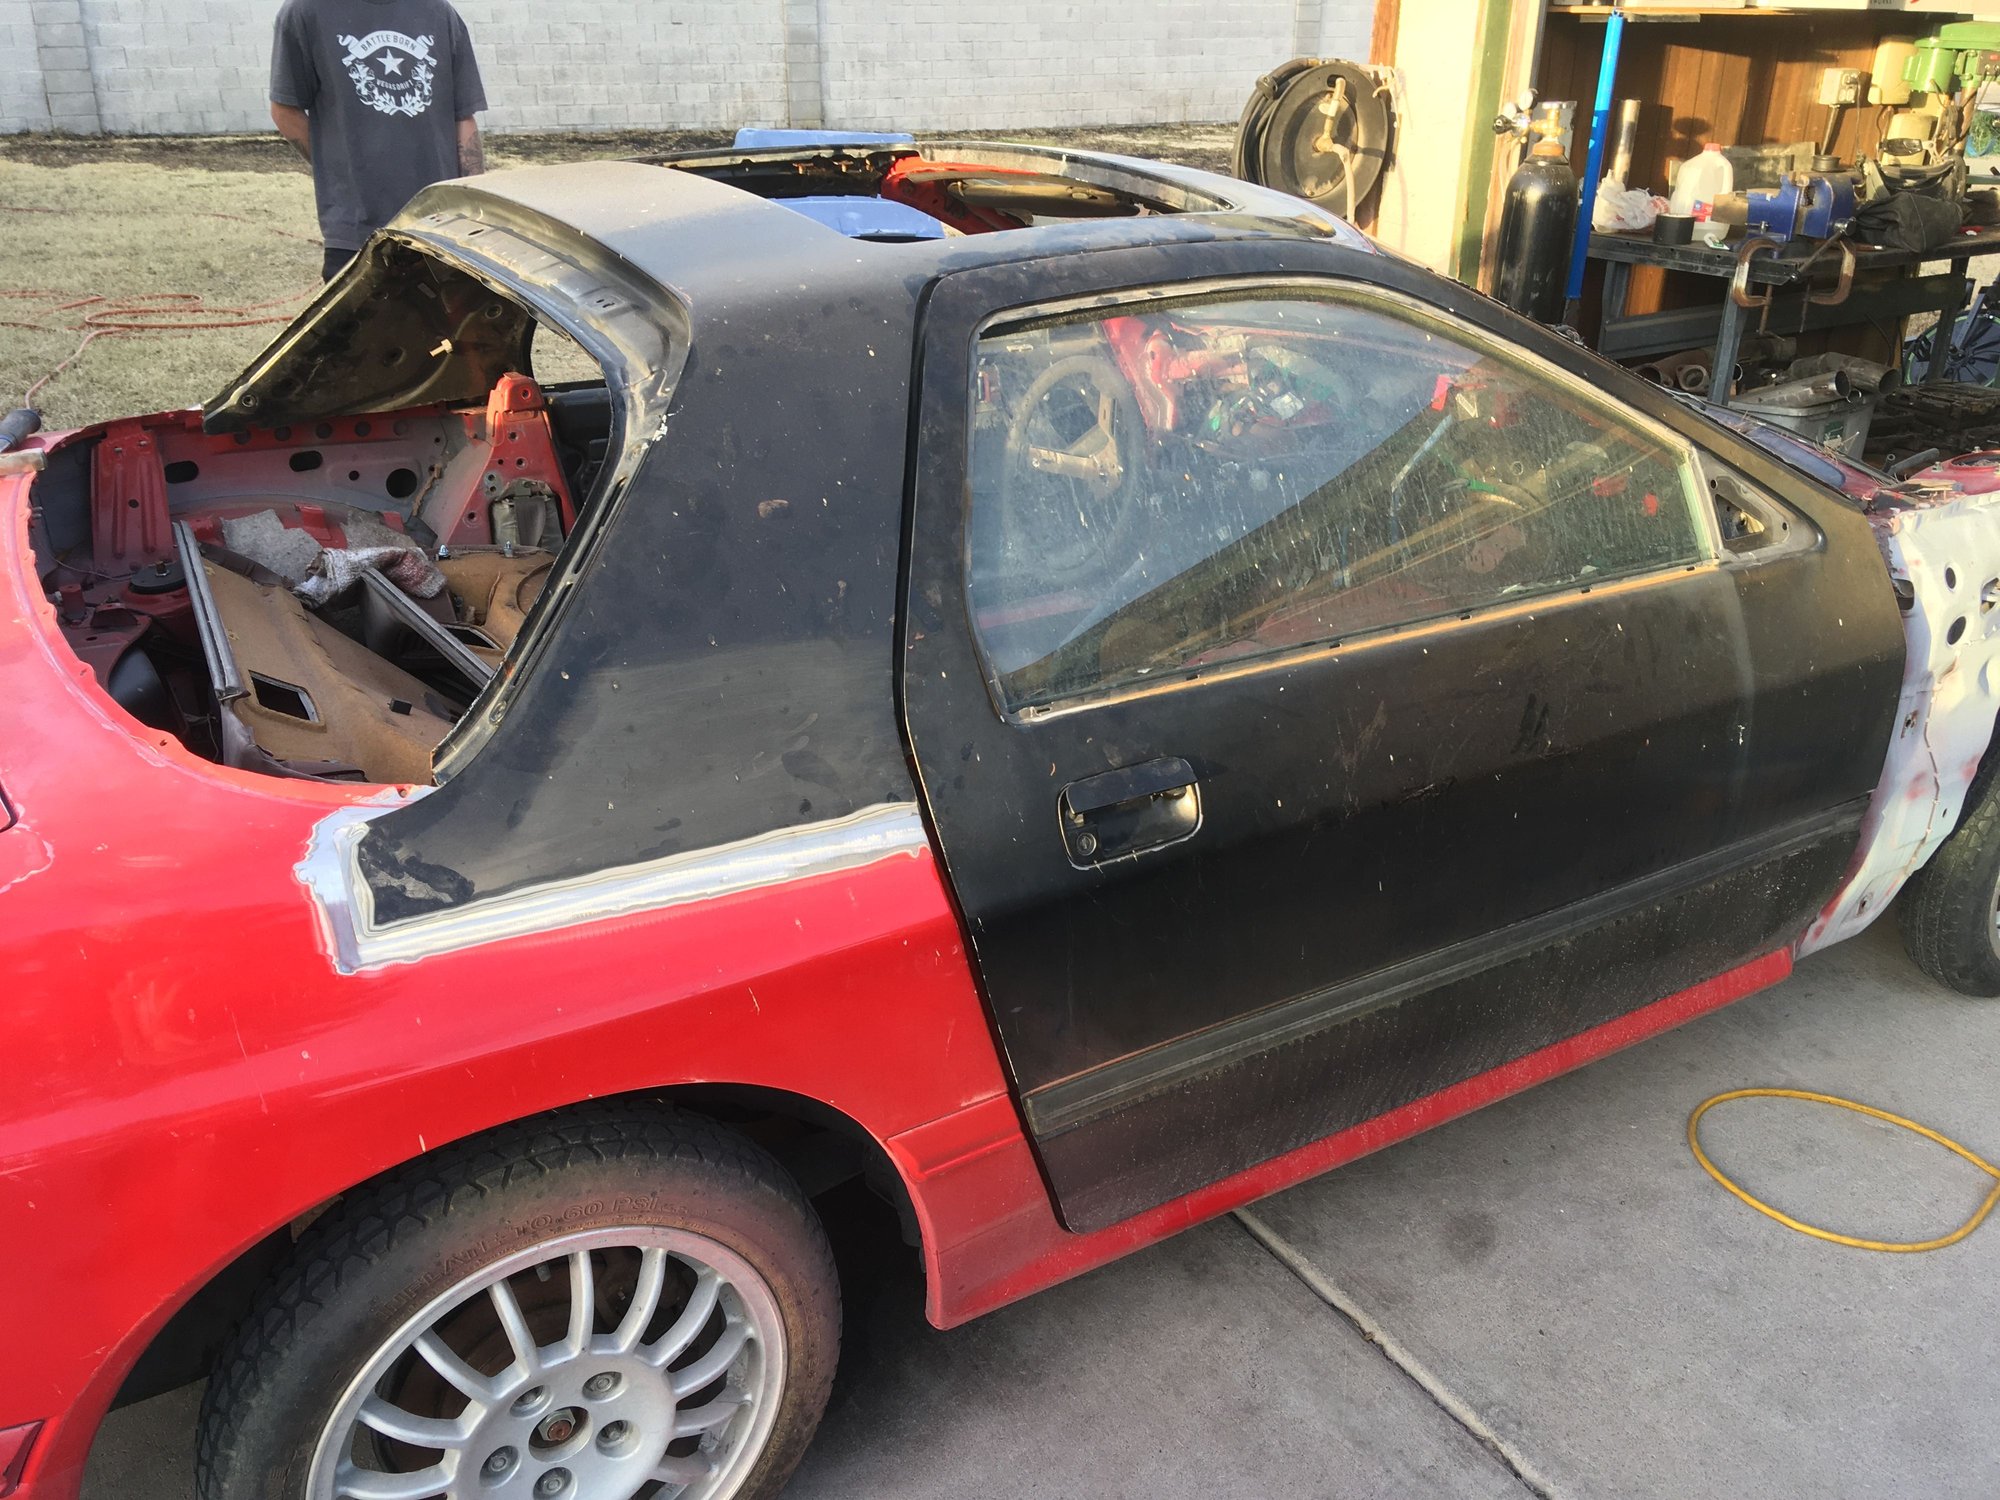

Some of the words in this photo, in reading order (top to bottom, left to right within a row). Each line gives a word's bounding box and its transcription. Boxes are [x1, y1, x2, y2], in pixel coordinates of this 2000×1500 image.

[360, 33, 392, 52] BATTLE
[393, 35, 417, 52] BORN
[562, 1200, 605, 1222] 60
[610, 1195, 659, 1213] PSI
